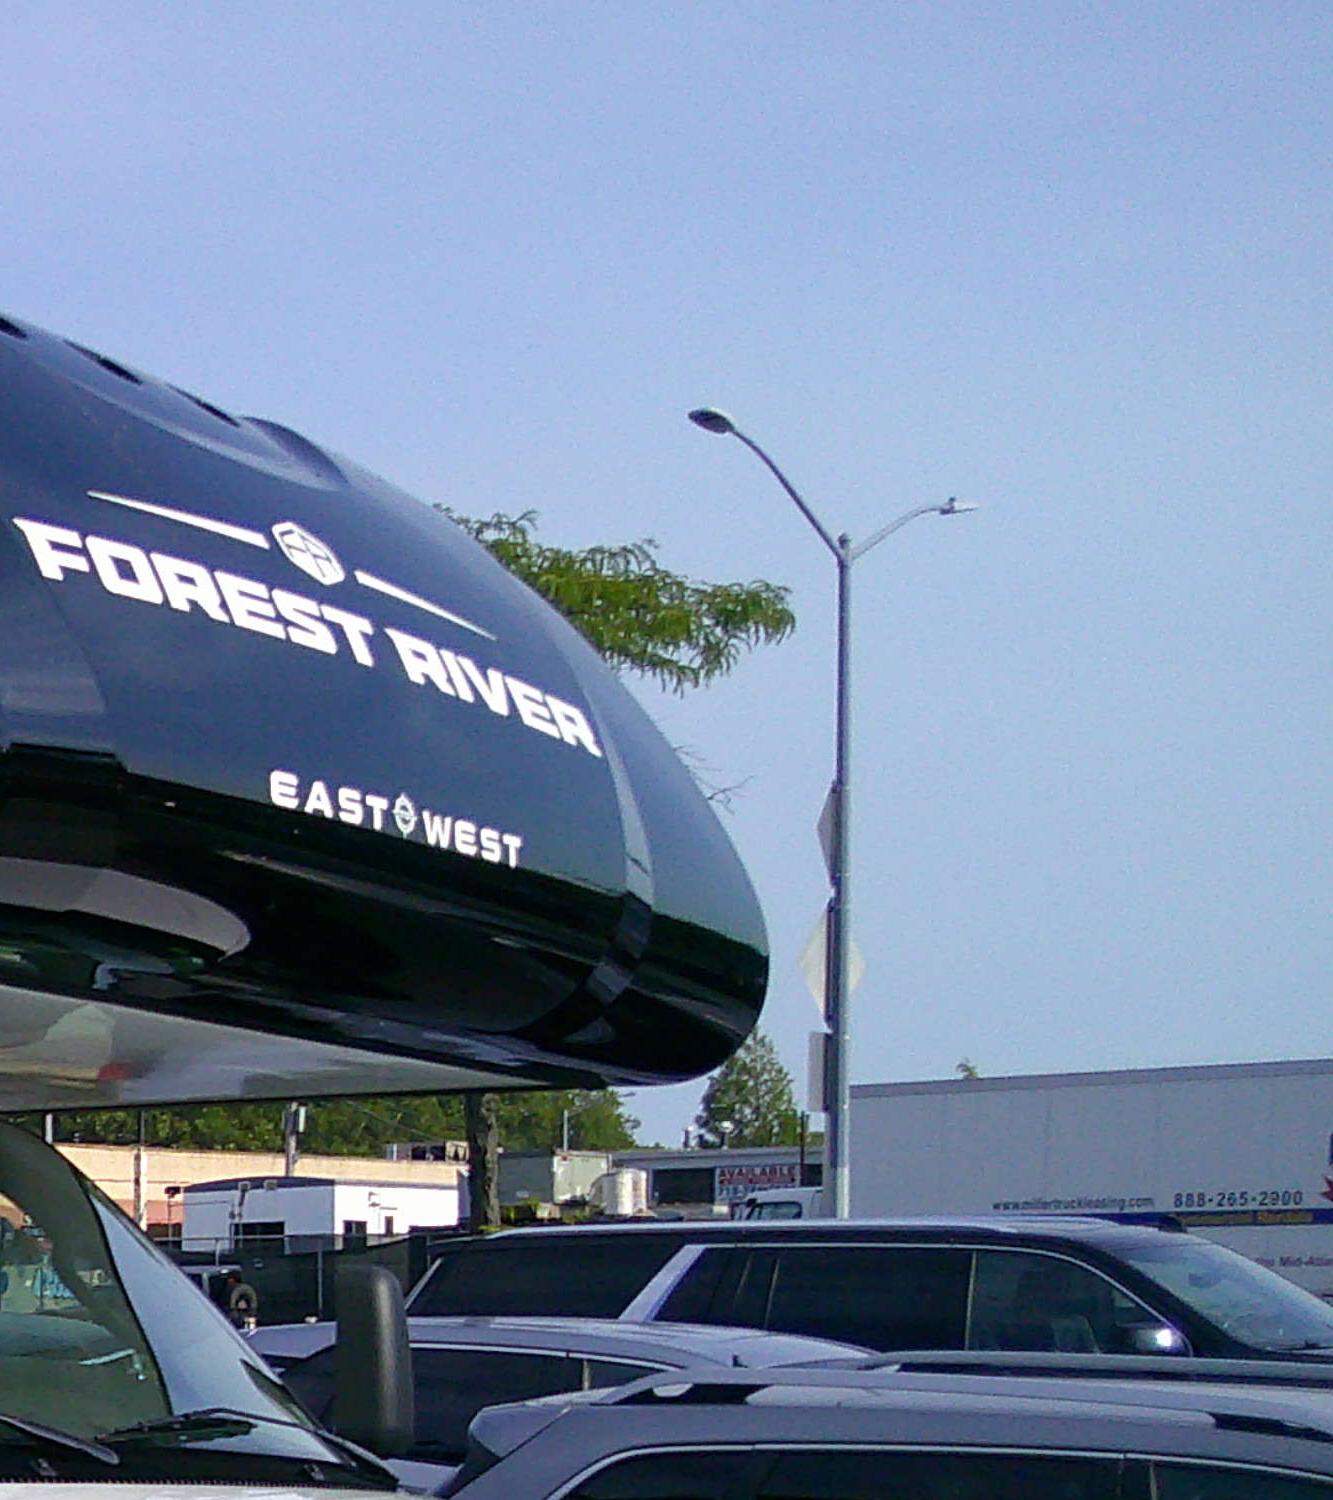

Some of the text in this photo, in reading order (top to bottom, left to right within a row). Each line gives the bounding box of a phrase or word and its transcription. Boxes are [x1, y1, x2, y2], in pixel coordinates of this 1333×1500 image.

[14, 516, 602, 758] FOREST RIVER
[269, 770, 524, 868] EAST WEST
